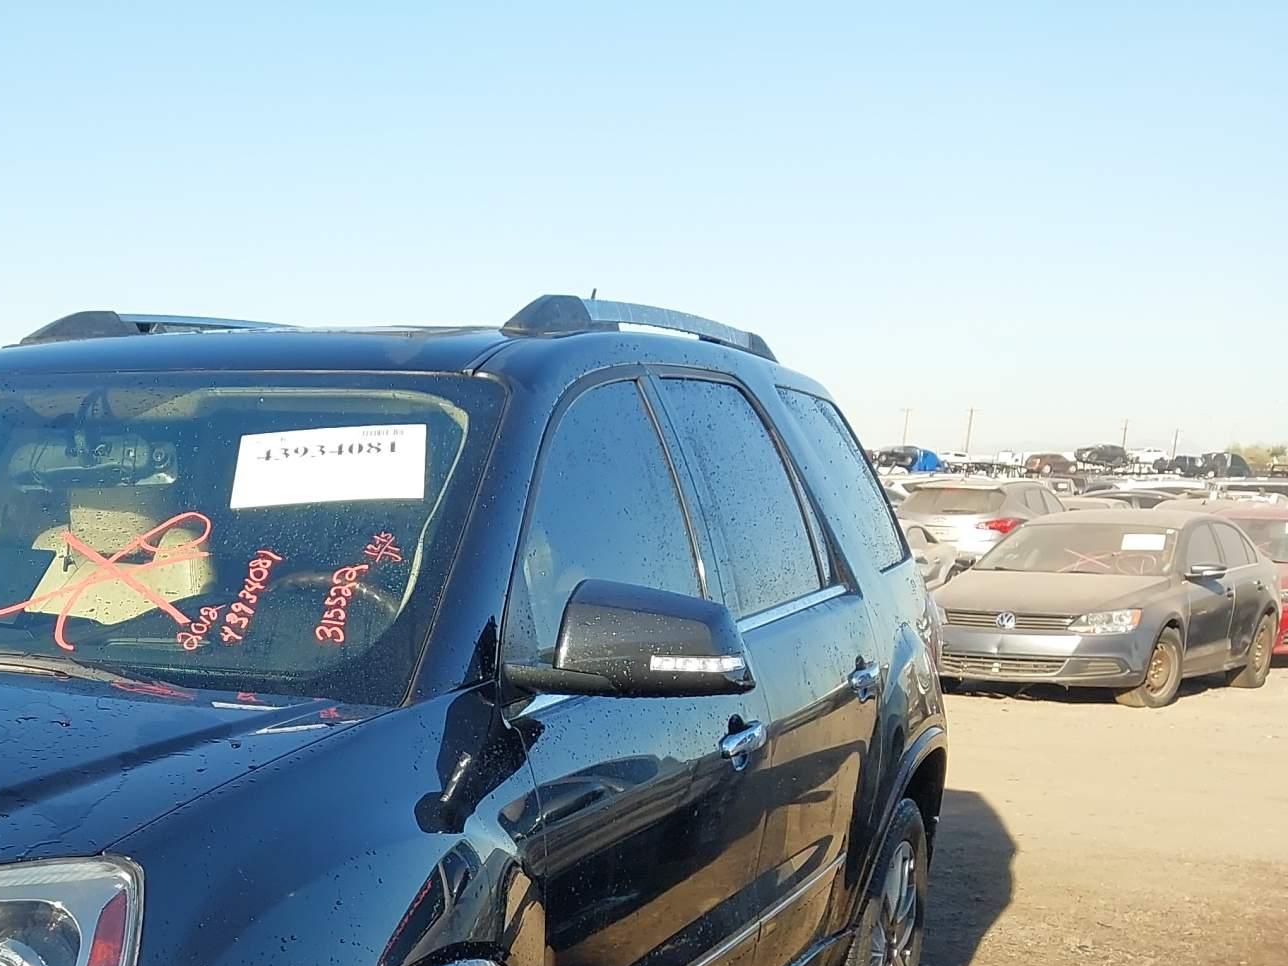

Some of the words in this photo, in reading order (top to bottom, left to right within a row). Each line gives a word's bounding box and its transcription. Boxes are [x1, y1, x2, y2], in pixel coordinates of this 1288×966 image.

[177, 604, 226, 650] 2012
[220, 550, 283, 643] 43934081
[315, 564, 369, 643] 315522
